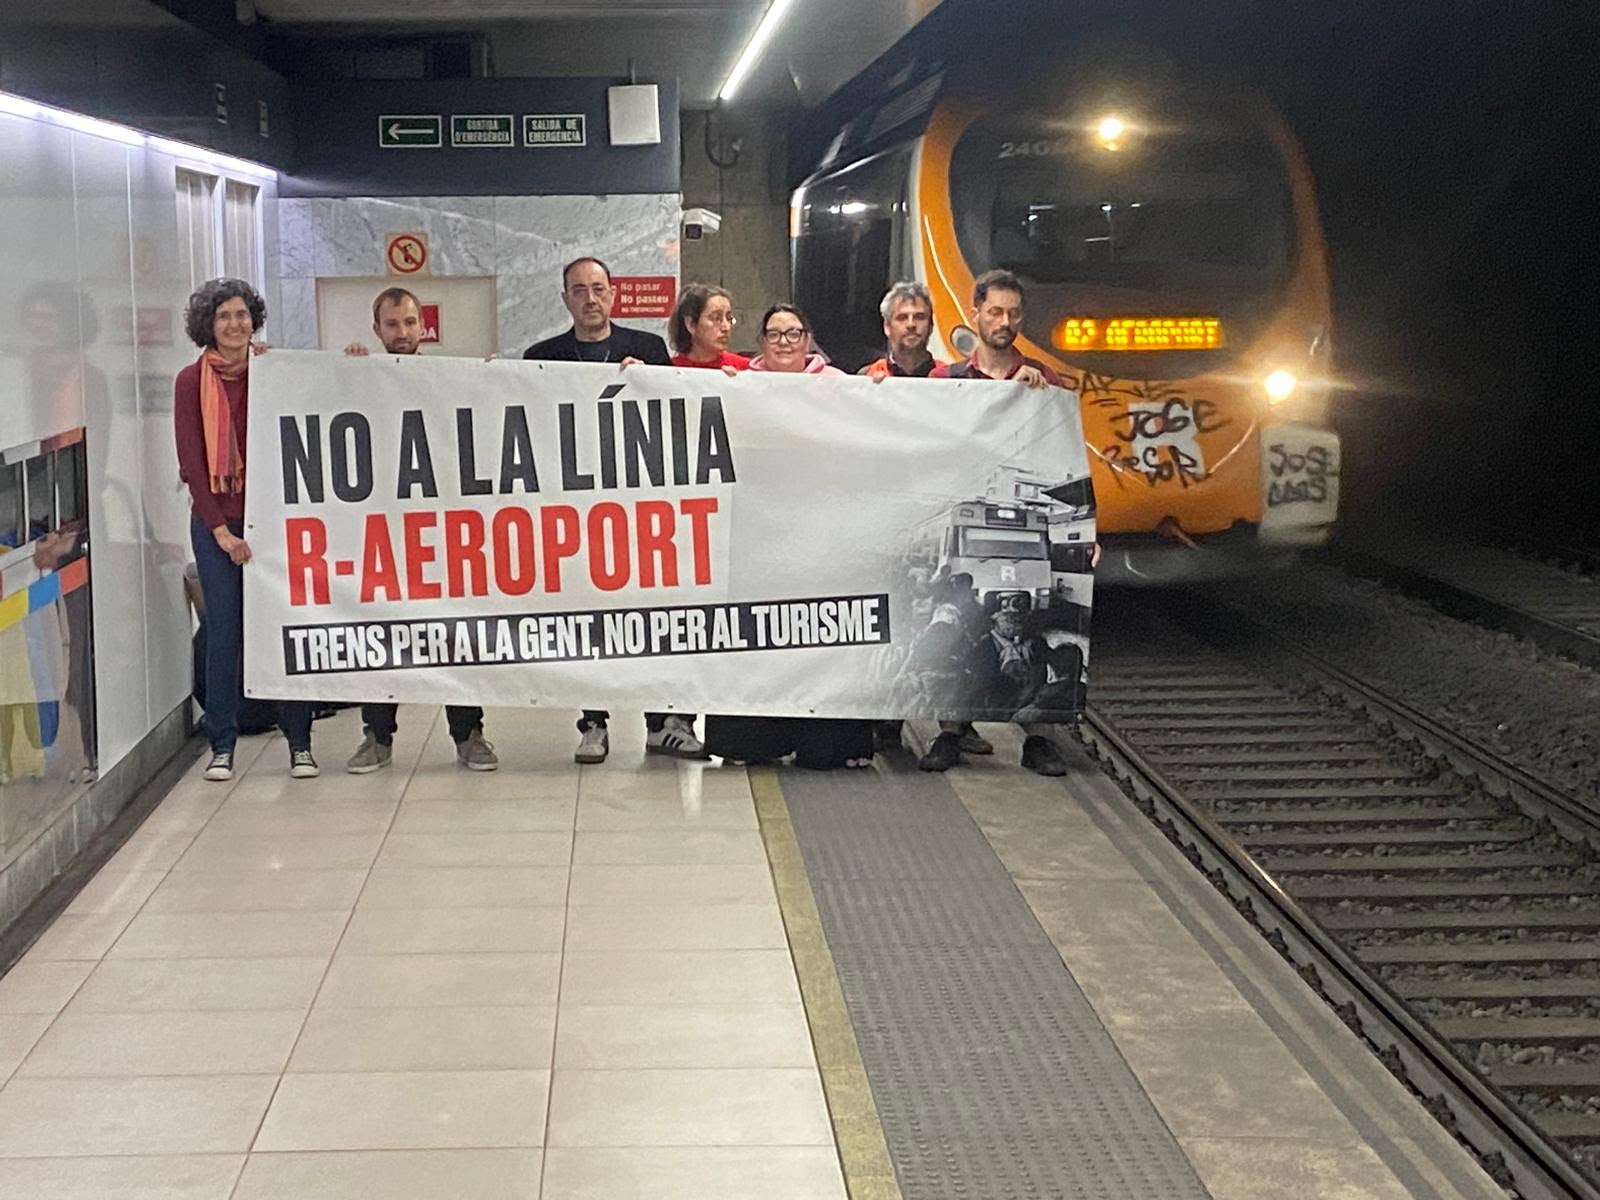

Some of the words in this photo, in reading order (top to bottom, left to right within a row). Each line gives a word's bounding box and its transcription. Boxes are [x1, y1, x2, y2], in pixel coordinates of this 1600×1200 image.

[528, 131, 582, 143] EMERGENCIA
[531, 119, 562, 131] SALIDA
[565, 119, 578, 131] DE
[621, 294, 634, 304] No
[280, 412, 374, 504] NO
[397, 410, 438, 499] A
[456, 405, 540, 496] LA
[558, 384, 736, 491] LÍNIA
[285, 497, 718, 606] R-AEROPORT
[288, 624, 386, 672] TRENS
[390, 621, 449, 667] PER
[453, 620, 475, 664] A
[477, 618, 515, 662] LA
[518, 614, 599, 661] GENT,
[603, 611, 645, 655] NO
[650, 609, 707, 653] PER
[712, 606, 748, 649] AL
[751, 598, 881, 647] TURISME
